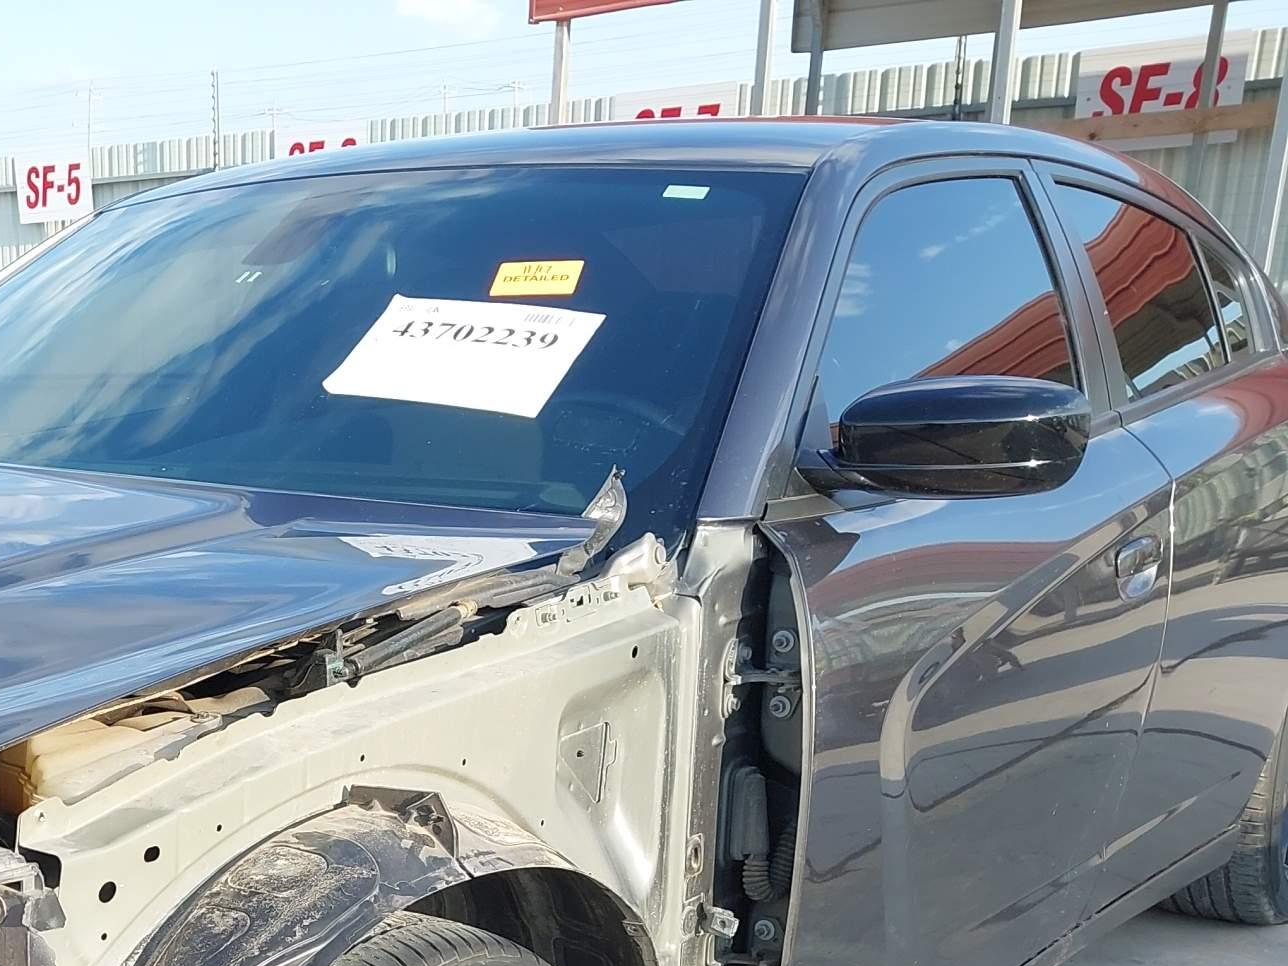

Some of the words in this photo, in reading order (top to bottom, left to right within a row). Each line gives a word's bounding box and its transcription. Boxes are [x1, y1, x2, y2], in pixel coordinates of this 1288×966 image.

[26, 163, 81, 209] SF-5
[502, 273, 571, 283] DETAILED
[392, 319, 560, 350] 43702239
